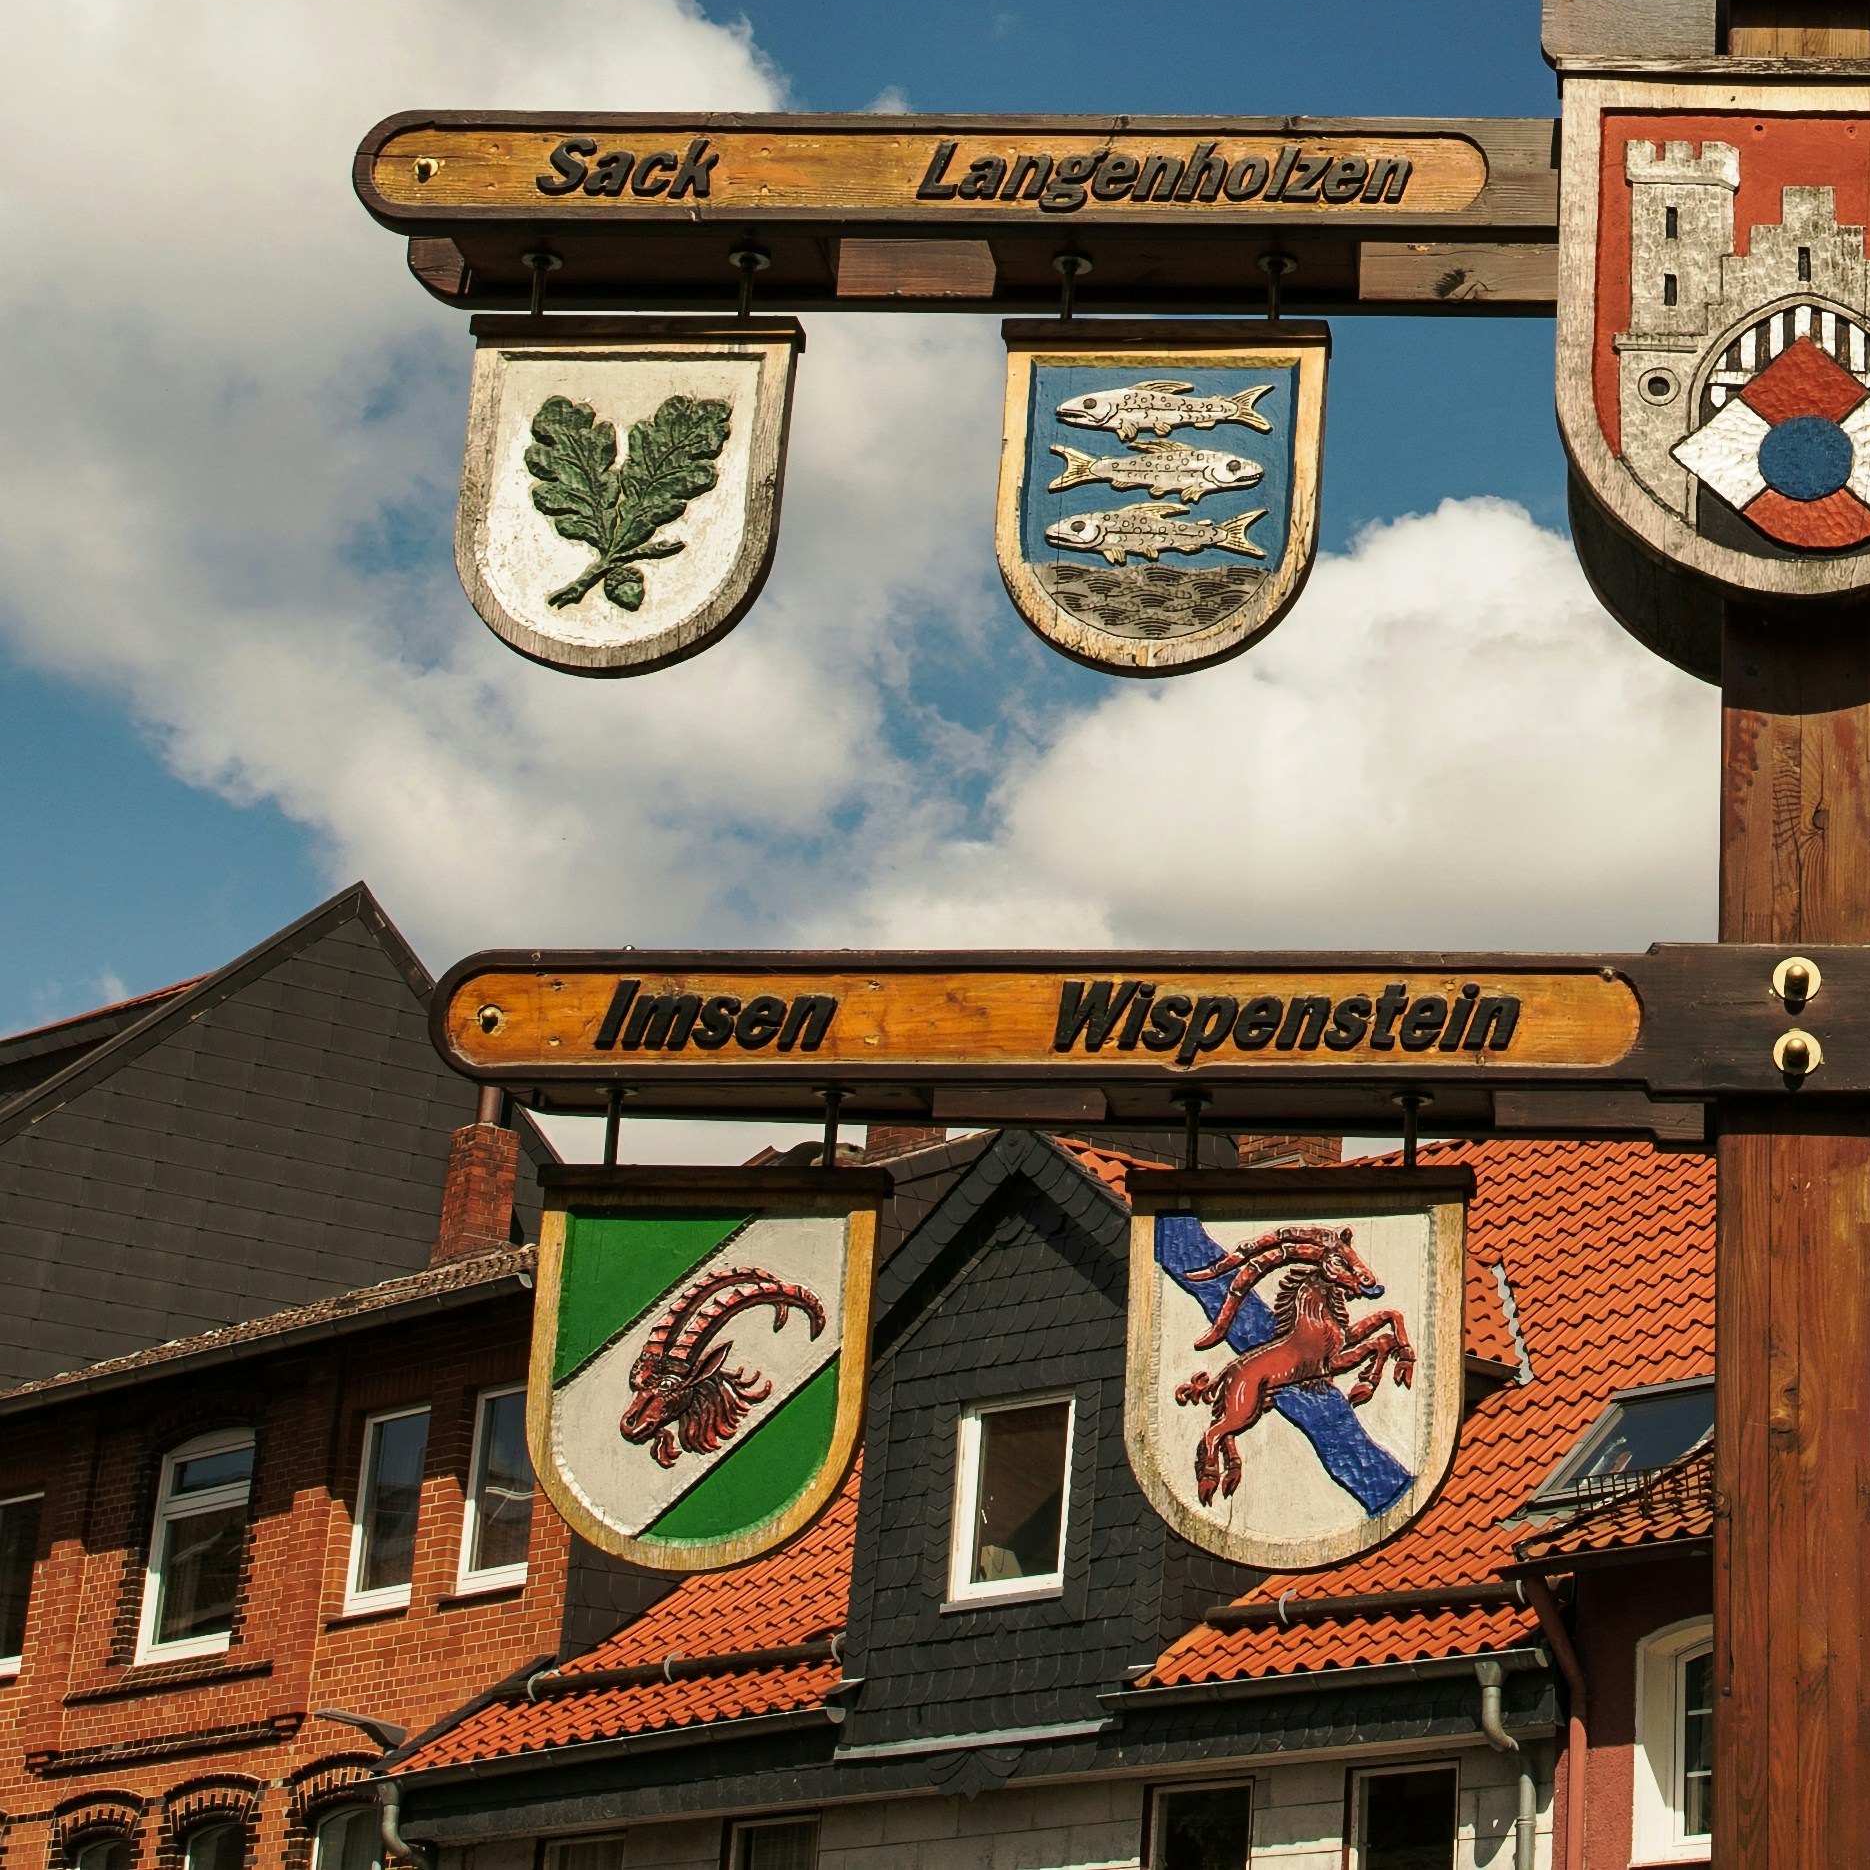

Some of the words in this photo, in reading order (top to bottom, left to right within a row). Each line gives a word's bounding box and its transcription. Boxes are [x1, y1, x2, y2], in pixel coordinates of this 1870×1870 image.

[536, 137, 719, 198] Sack
[915, 140, 1413, 213] Langenholzen
[594, 978, 838, 1052] Imsen
[1054, 980, 1521, 1065] Wispenstein
